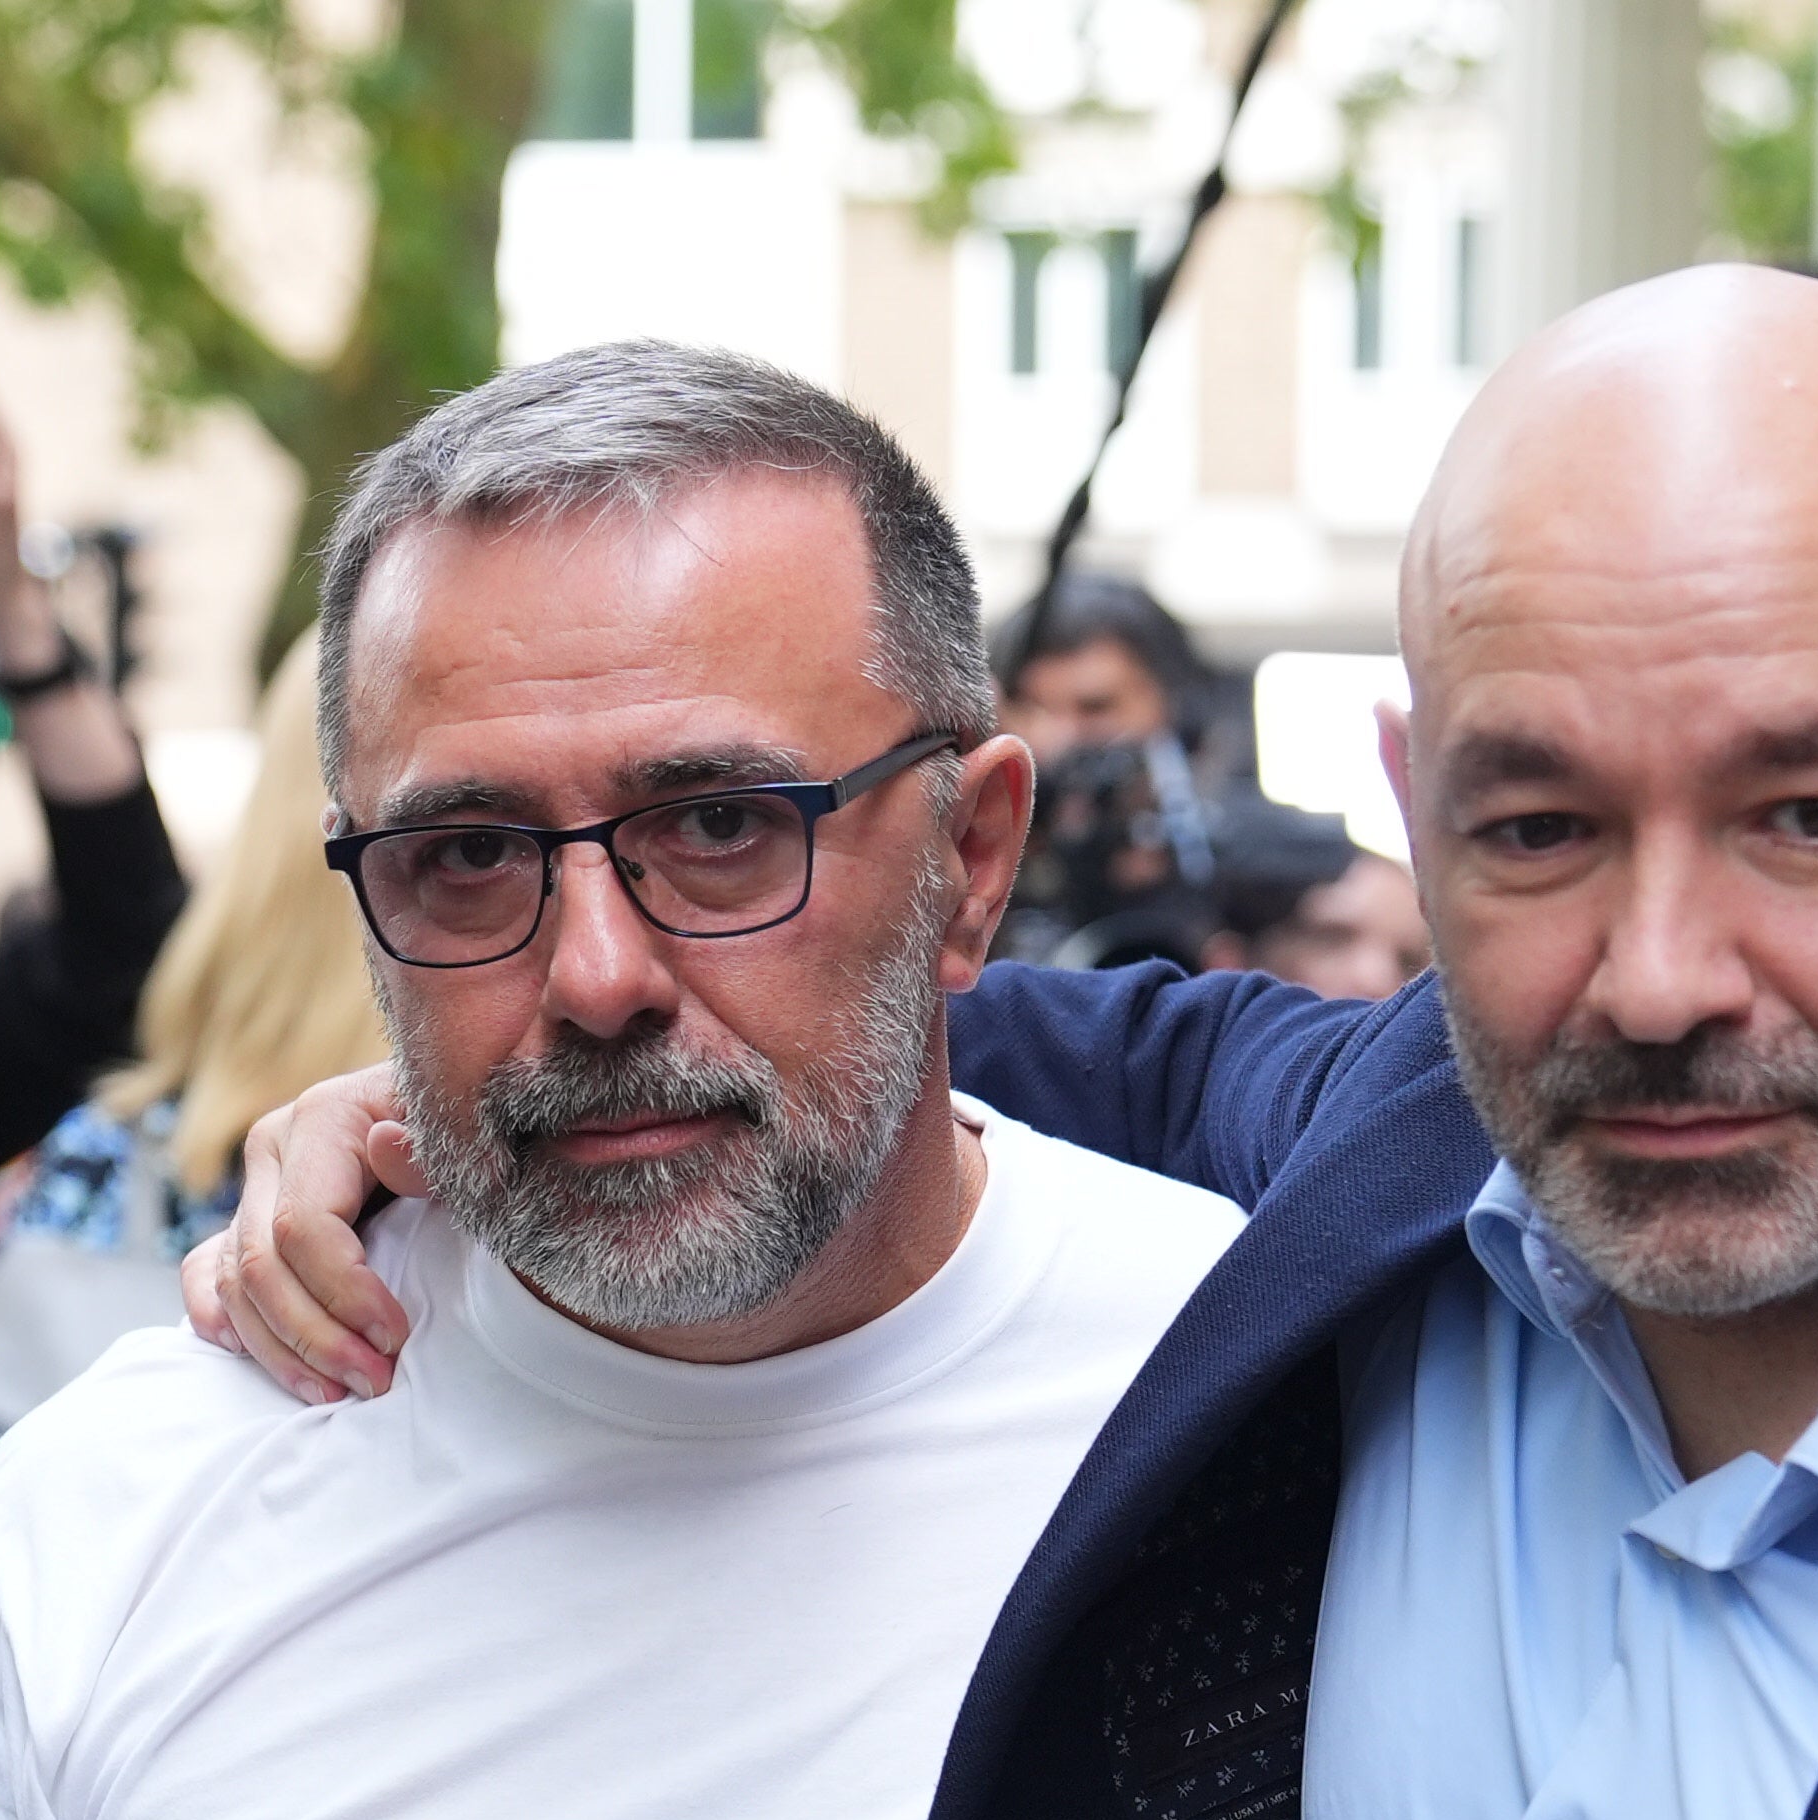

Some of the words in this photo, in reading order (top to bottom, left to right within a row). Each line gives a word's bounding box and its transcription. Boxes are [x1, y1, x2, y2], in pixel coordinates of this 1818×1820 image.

[1181, 1702, 1269, 1748] ZARA
[1234, 1807, 1255, 1820] USA
[1254, 1802, 1265, 1813] 38
[1270, 1791, 1289, 1806] MEX
